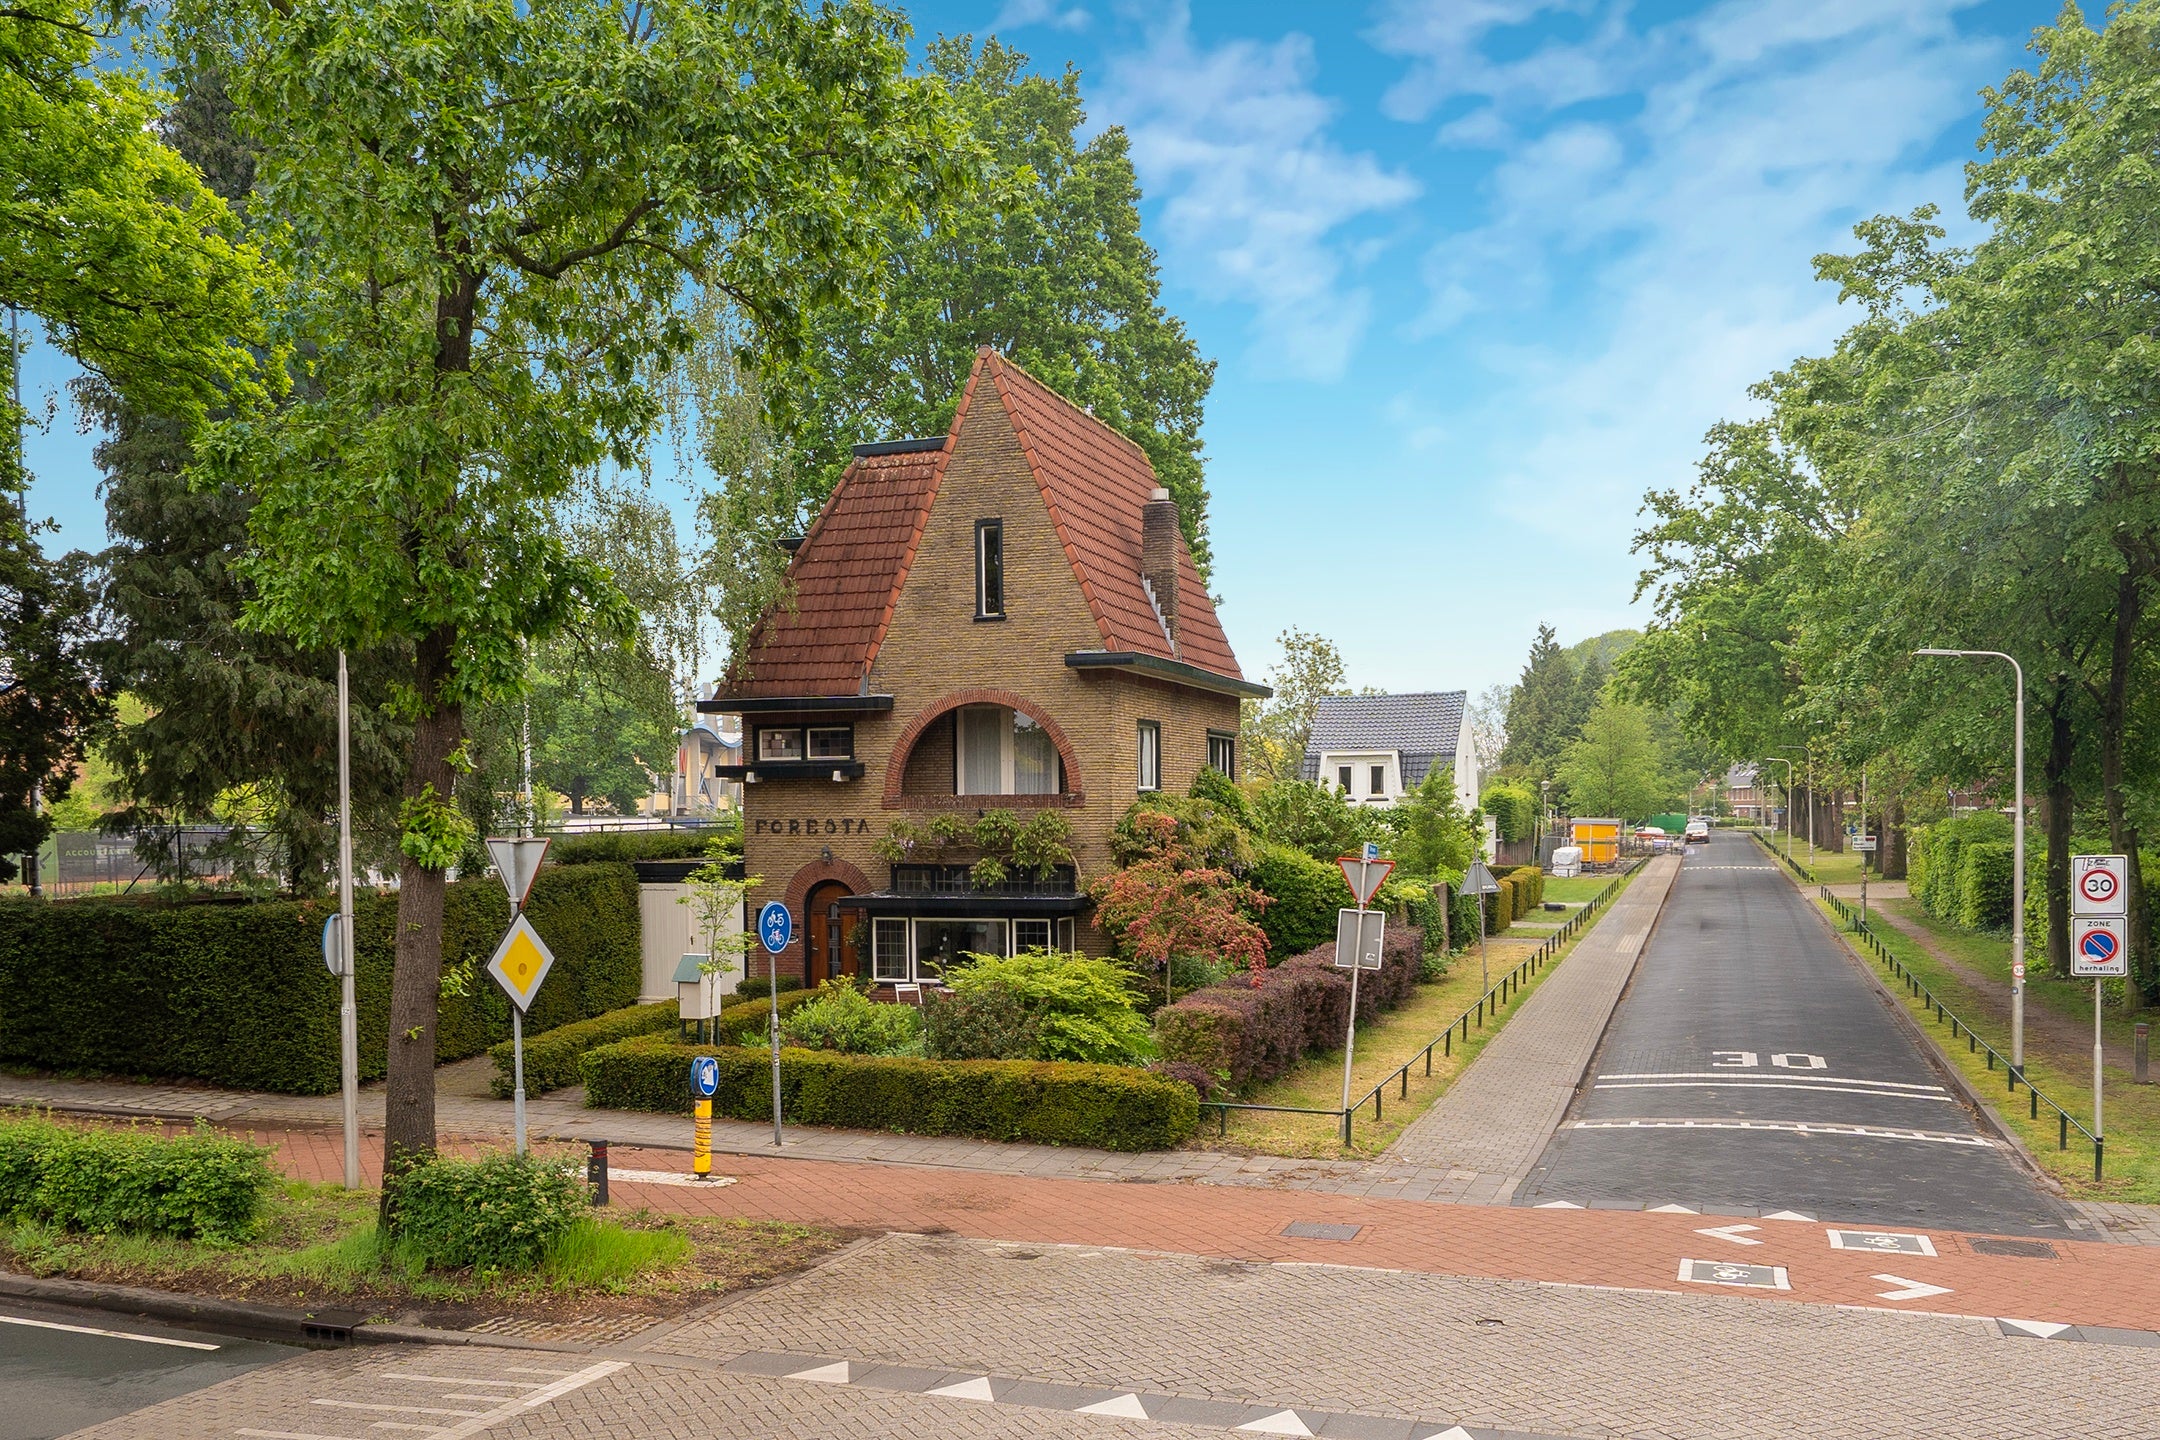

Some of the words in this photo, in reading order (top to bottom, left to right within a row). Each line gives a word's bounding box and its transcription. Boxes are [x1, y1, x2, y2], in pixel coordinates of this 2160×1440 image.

[755, 818, 869, 834] FORESTA
[2087, 859, 2111, 867] ZE
[2087, 879, 2112, 892] 30
[2080, 965, 2119, 973] herhaling
[1713, 1051, 1828, 1069] 30
